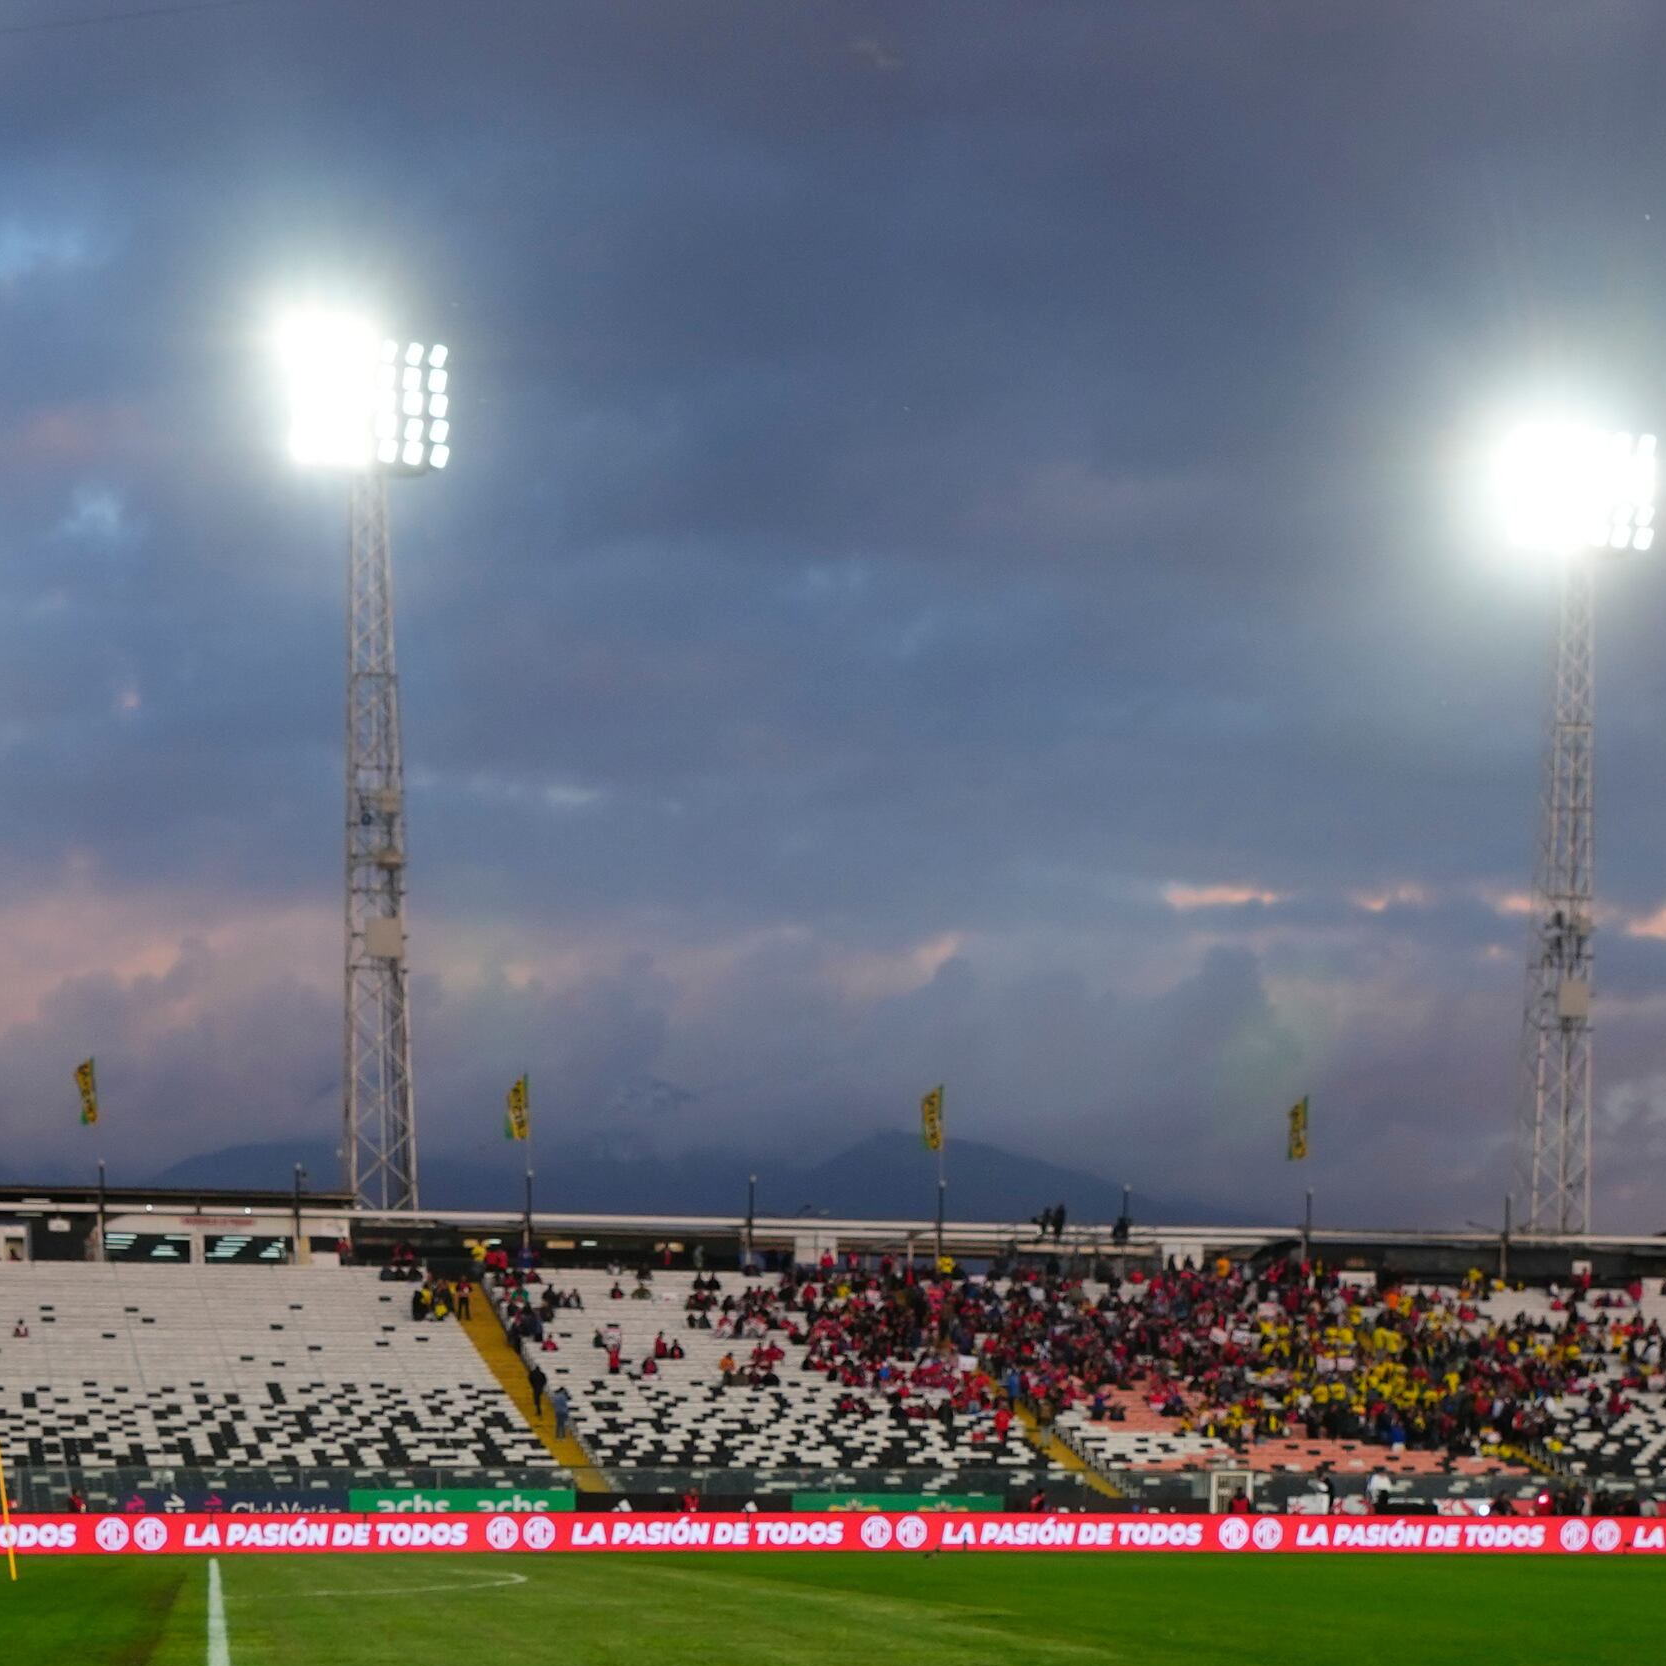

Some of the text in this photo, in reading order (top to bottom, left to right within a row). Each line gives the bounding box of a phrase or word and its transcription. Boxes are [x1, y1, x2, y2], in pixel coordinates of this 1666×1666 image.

[184, 1518, 468, 1546] LA PASIÓN DE TODOS
[571, 1517, 844, 1545] LA PASIÓN DE TODOS
[942, 1516, 1203, 1545] LA PASIÓN DE TODOS
[1296, 1519, 1545, 1547] LA PASIÓN DE TODOS
[1633, 1526, 1665, 1548] LA
